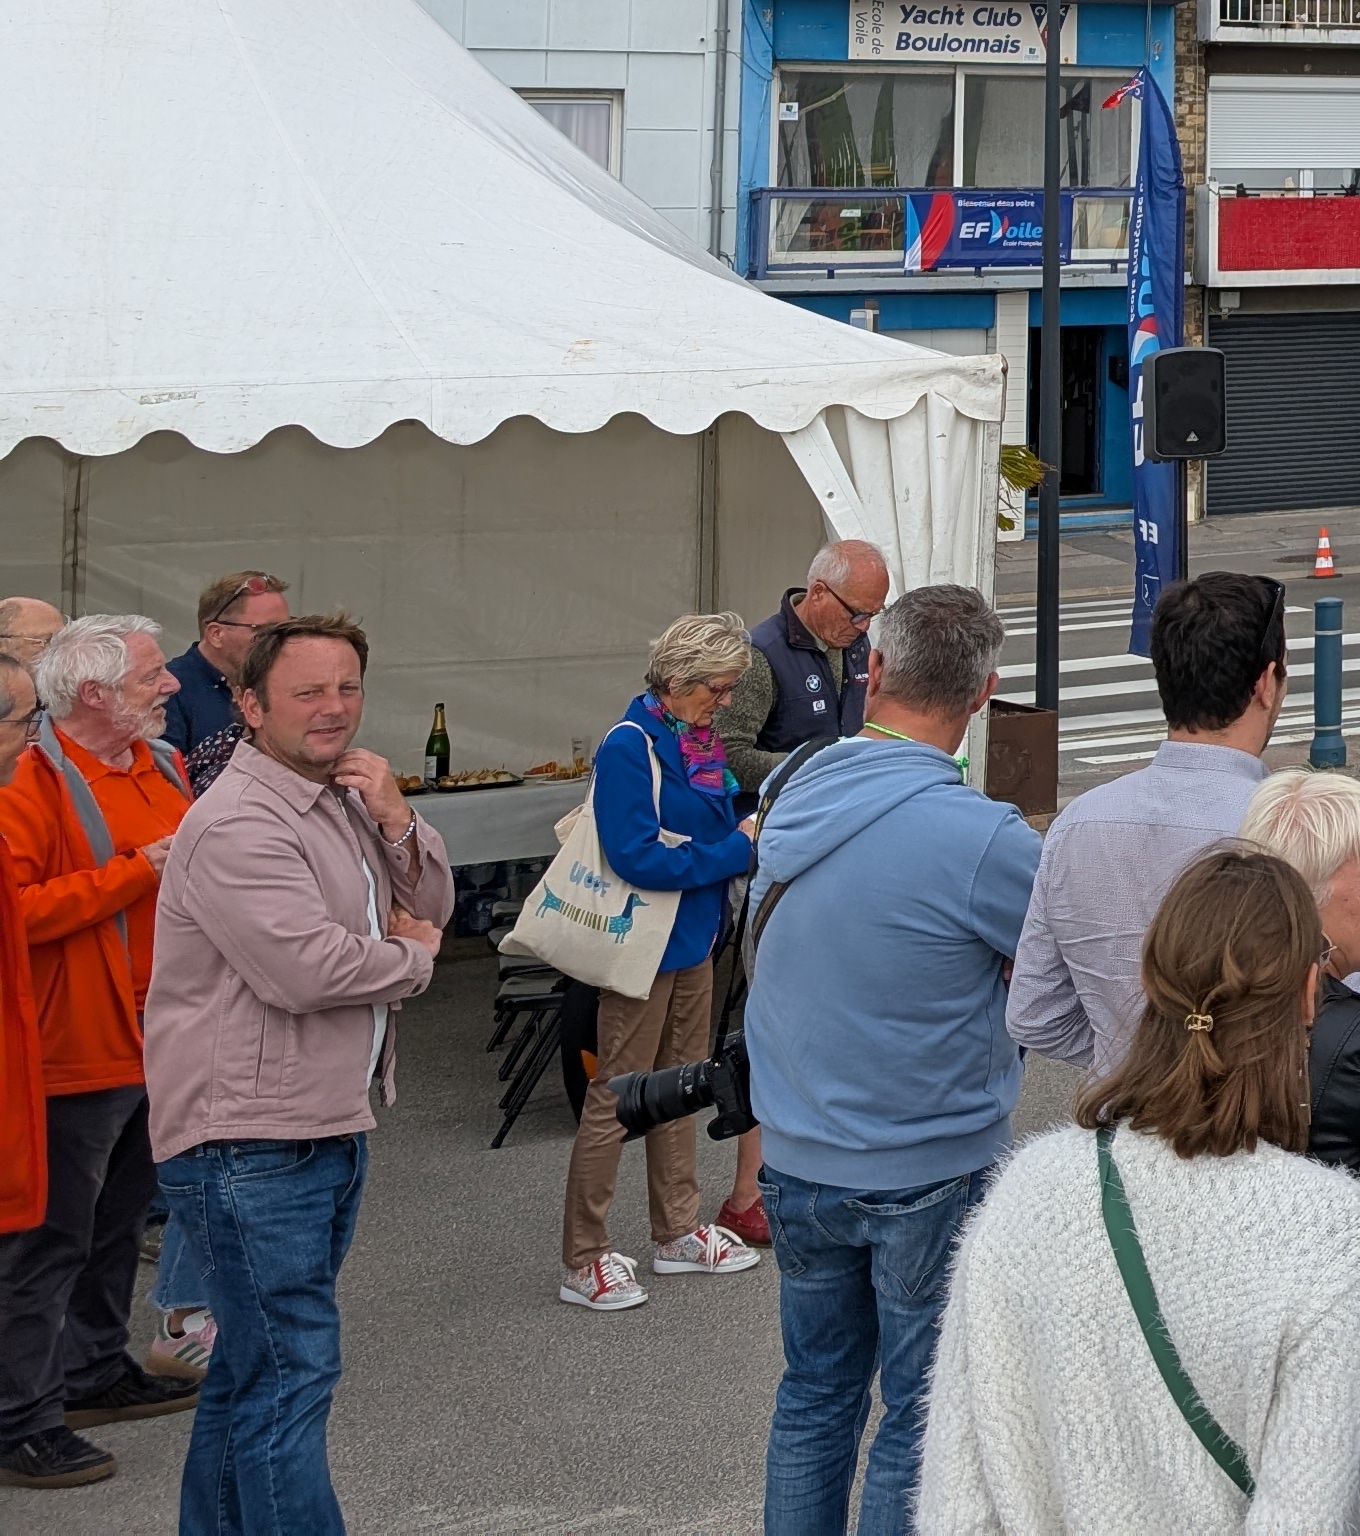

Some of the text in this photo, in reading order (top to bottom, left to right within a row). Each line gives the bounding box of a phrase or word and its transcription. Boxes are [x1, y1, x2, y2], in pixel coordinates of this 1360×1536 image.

[855, 11, 869, 45] Voile
[871, 0, 885, 55] Ecole de
[899, 4, 1022, 27] Yacht Club
[896, 32, 1021, 54] Boulonnais
